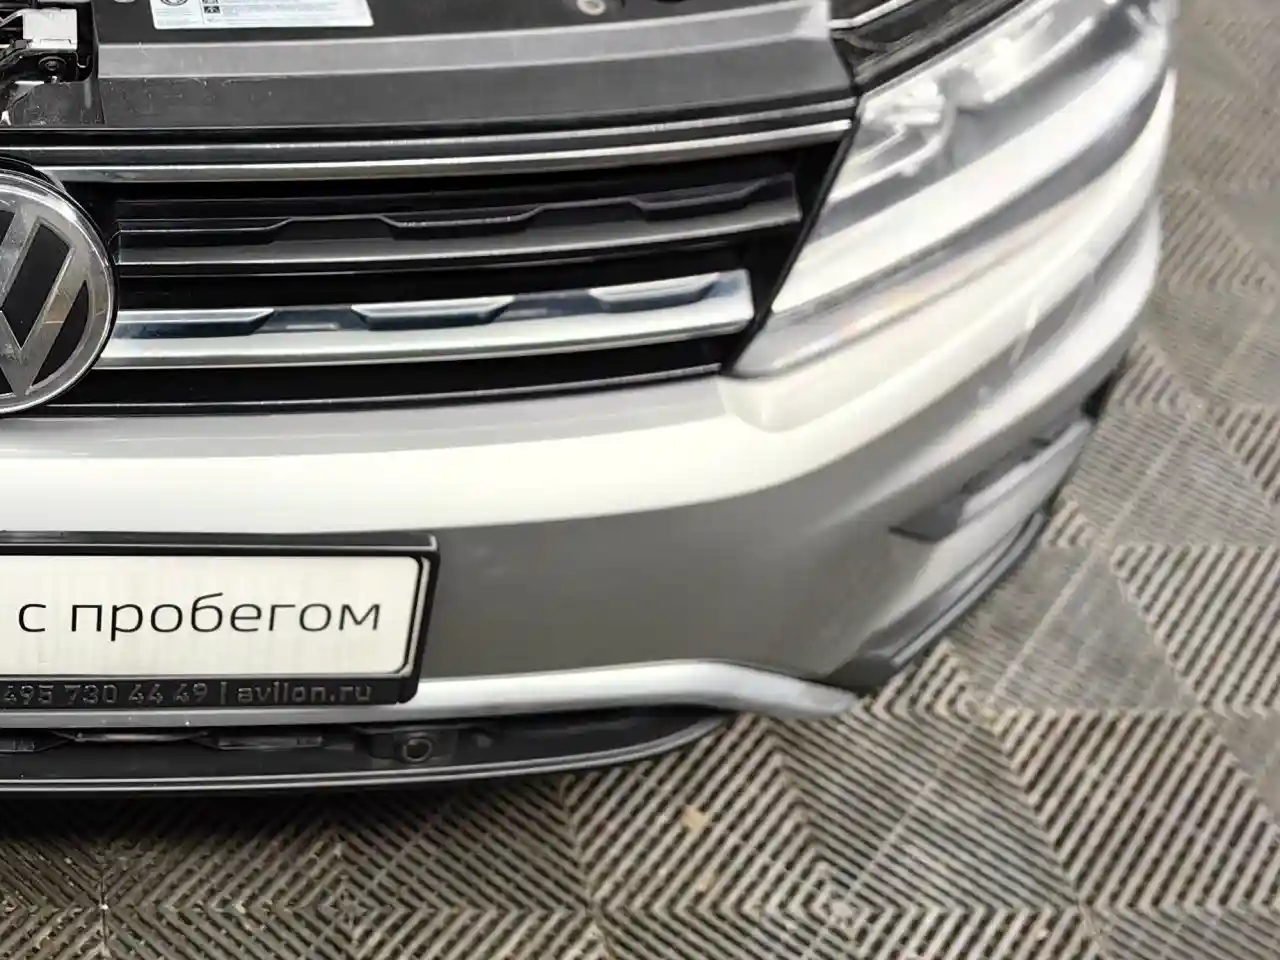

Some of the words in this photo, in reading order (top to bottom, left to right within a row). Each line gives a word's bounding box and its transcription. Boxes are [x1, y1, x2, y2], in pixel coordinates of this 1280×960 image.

[18, 603, 47, 632] с
[71, 592, 380, 641] пробегом
[2, 683, 54, 706] 495
[64, 683, 118, 705] 730
[127, 683, 164, 705] 44
[174, 681, 209, 704] 49
[236, 680, 374, 703] avilon.ru
